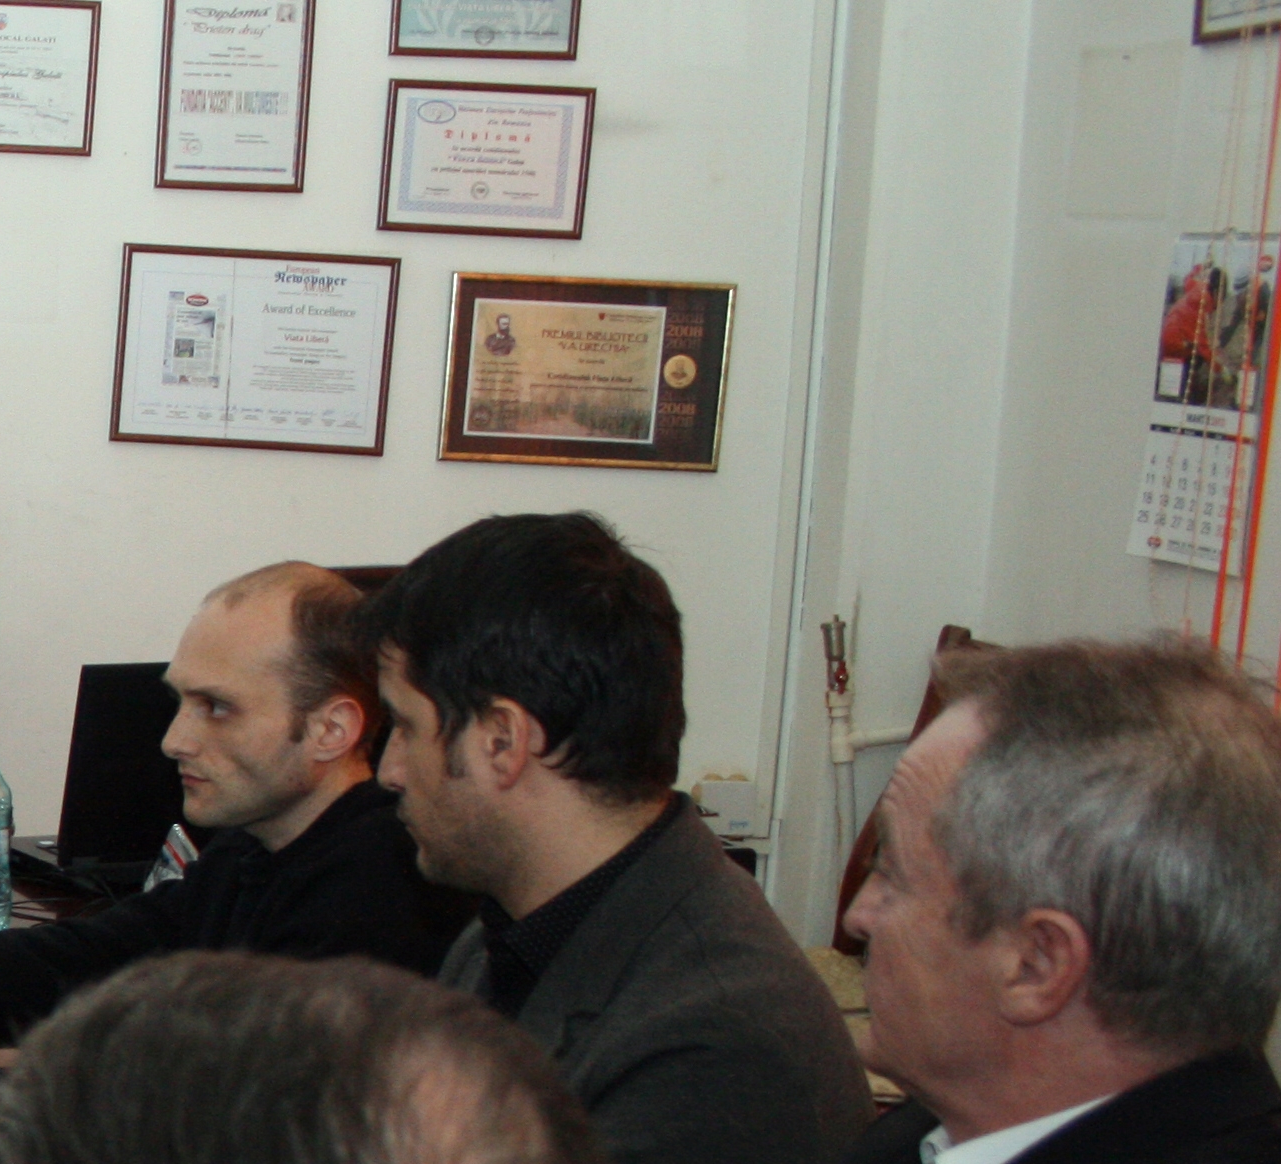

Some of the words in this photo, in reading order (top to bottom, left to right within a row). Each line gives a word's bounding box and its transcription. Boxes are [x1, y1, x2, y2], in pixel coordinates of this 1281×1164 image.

[275, 271, 347, 286] Newspaper
[262, 303, 293, 314] Award
[308, 305, 357, 317] Excellence
